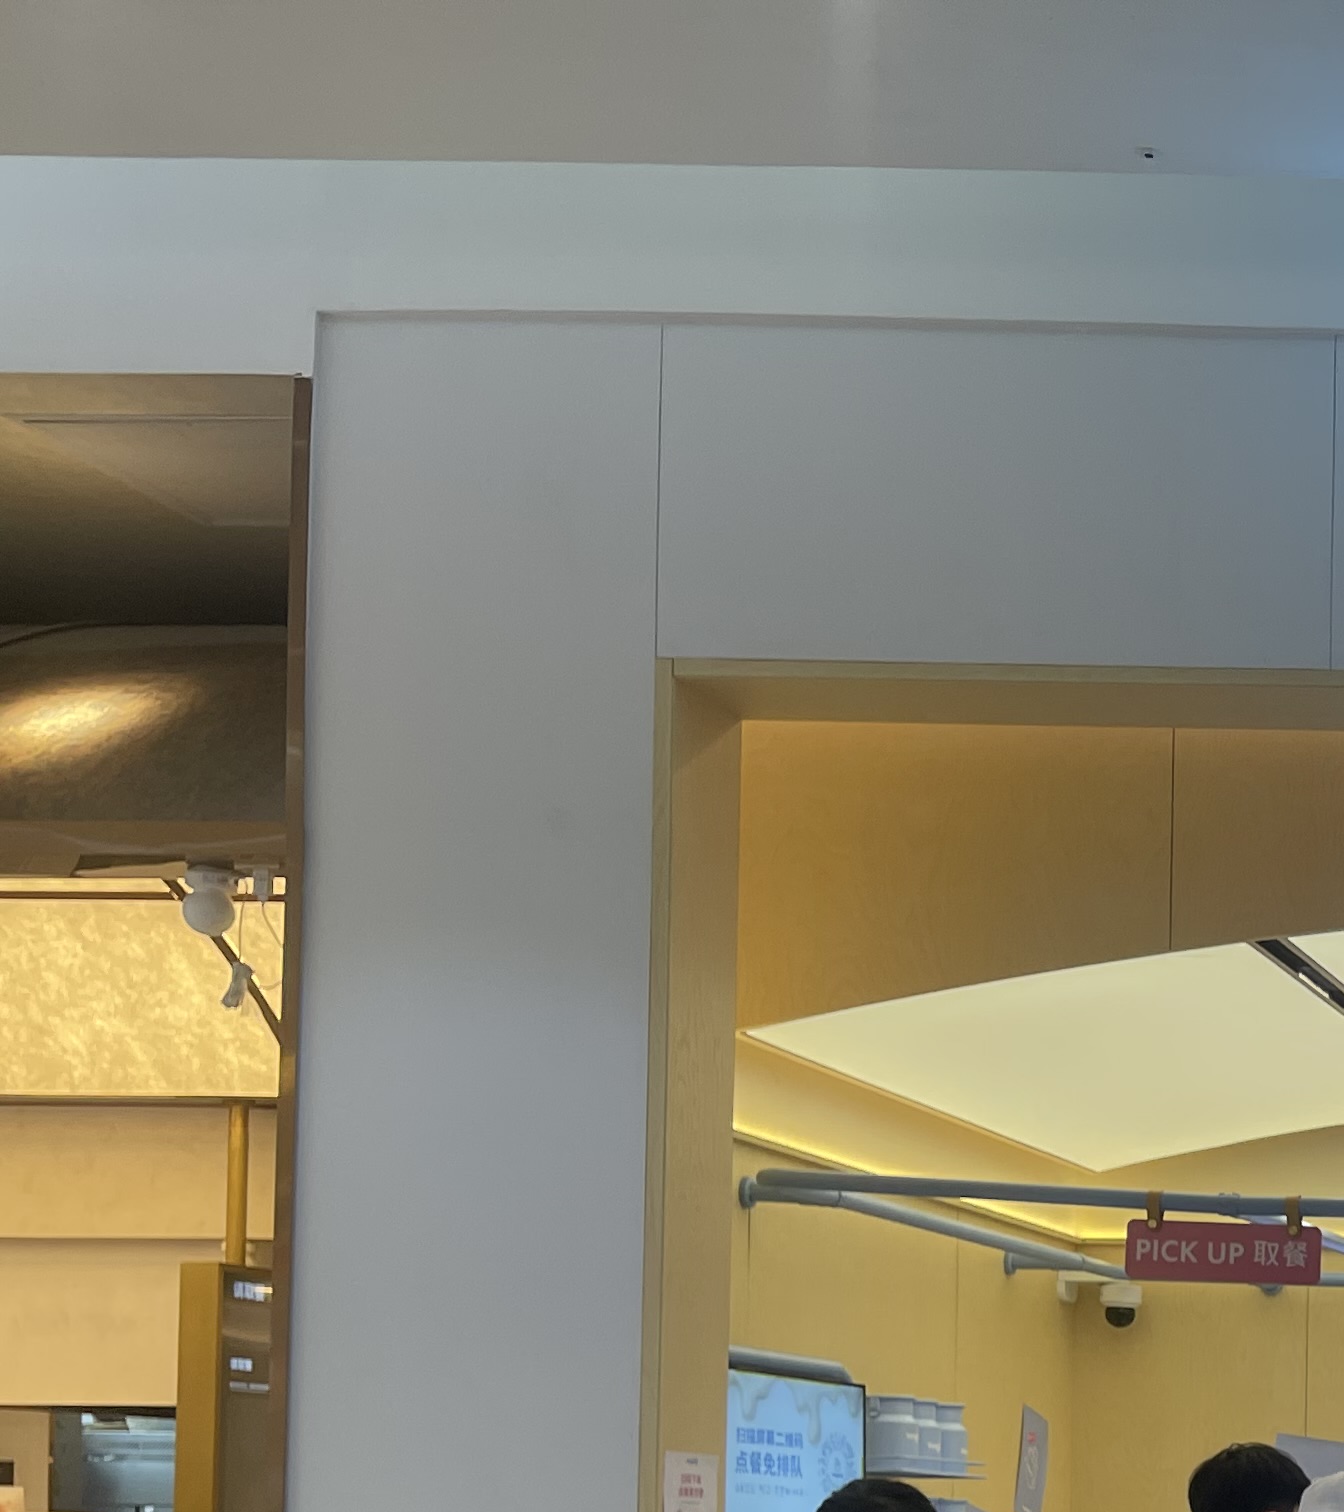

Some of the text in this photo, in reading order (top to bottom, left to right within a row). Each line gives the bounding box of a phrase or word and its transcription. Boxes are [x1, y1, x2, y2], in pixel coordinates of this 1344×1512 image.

[1135, 1238, 1309, 1268] PICK UP 取餐
[735, 1450, 803, 1479] 点餐免排队
